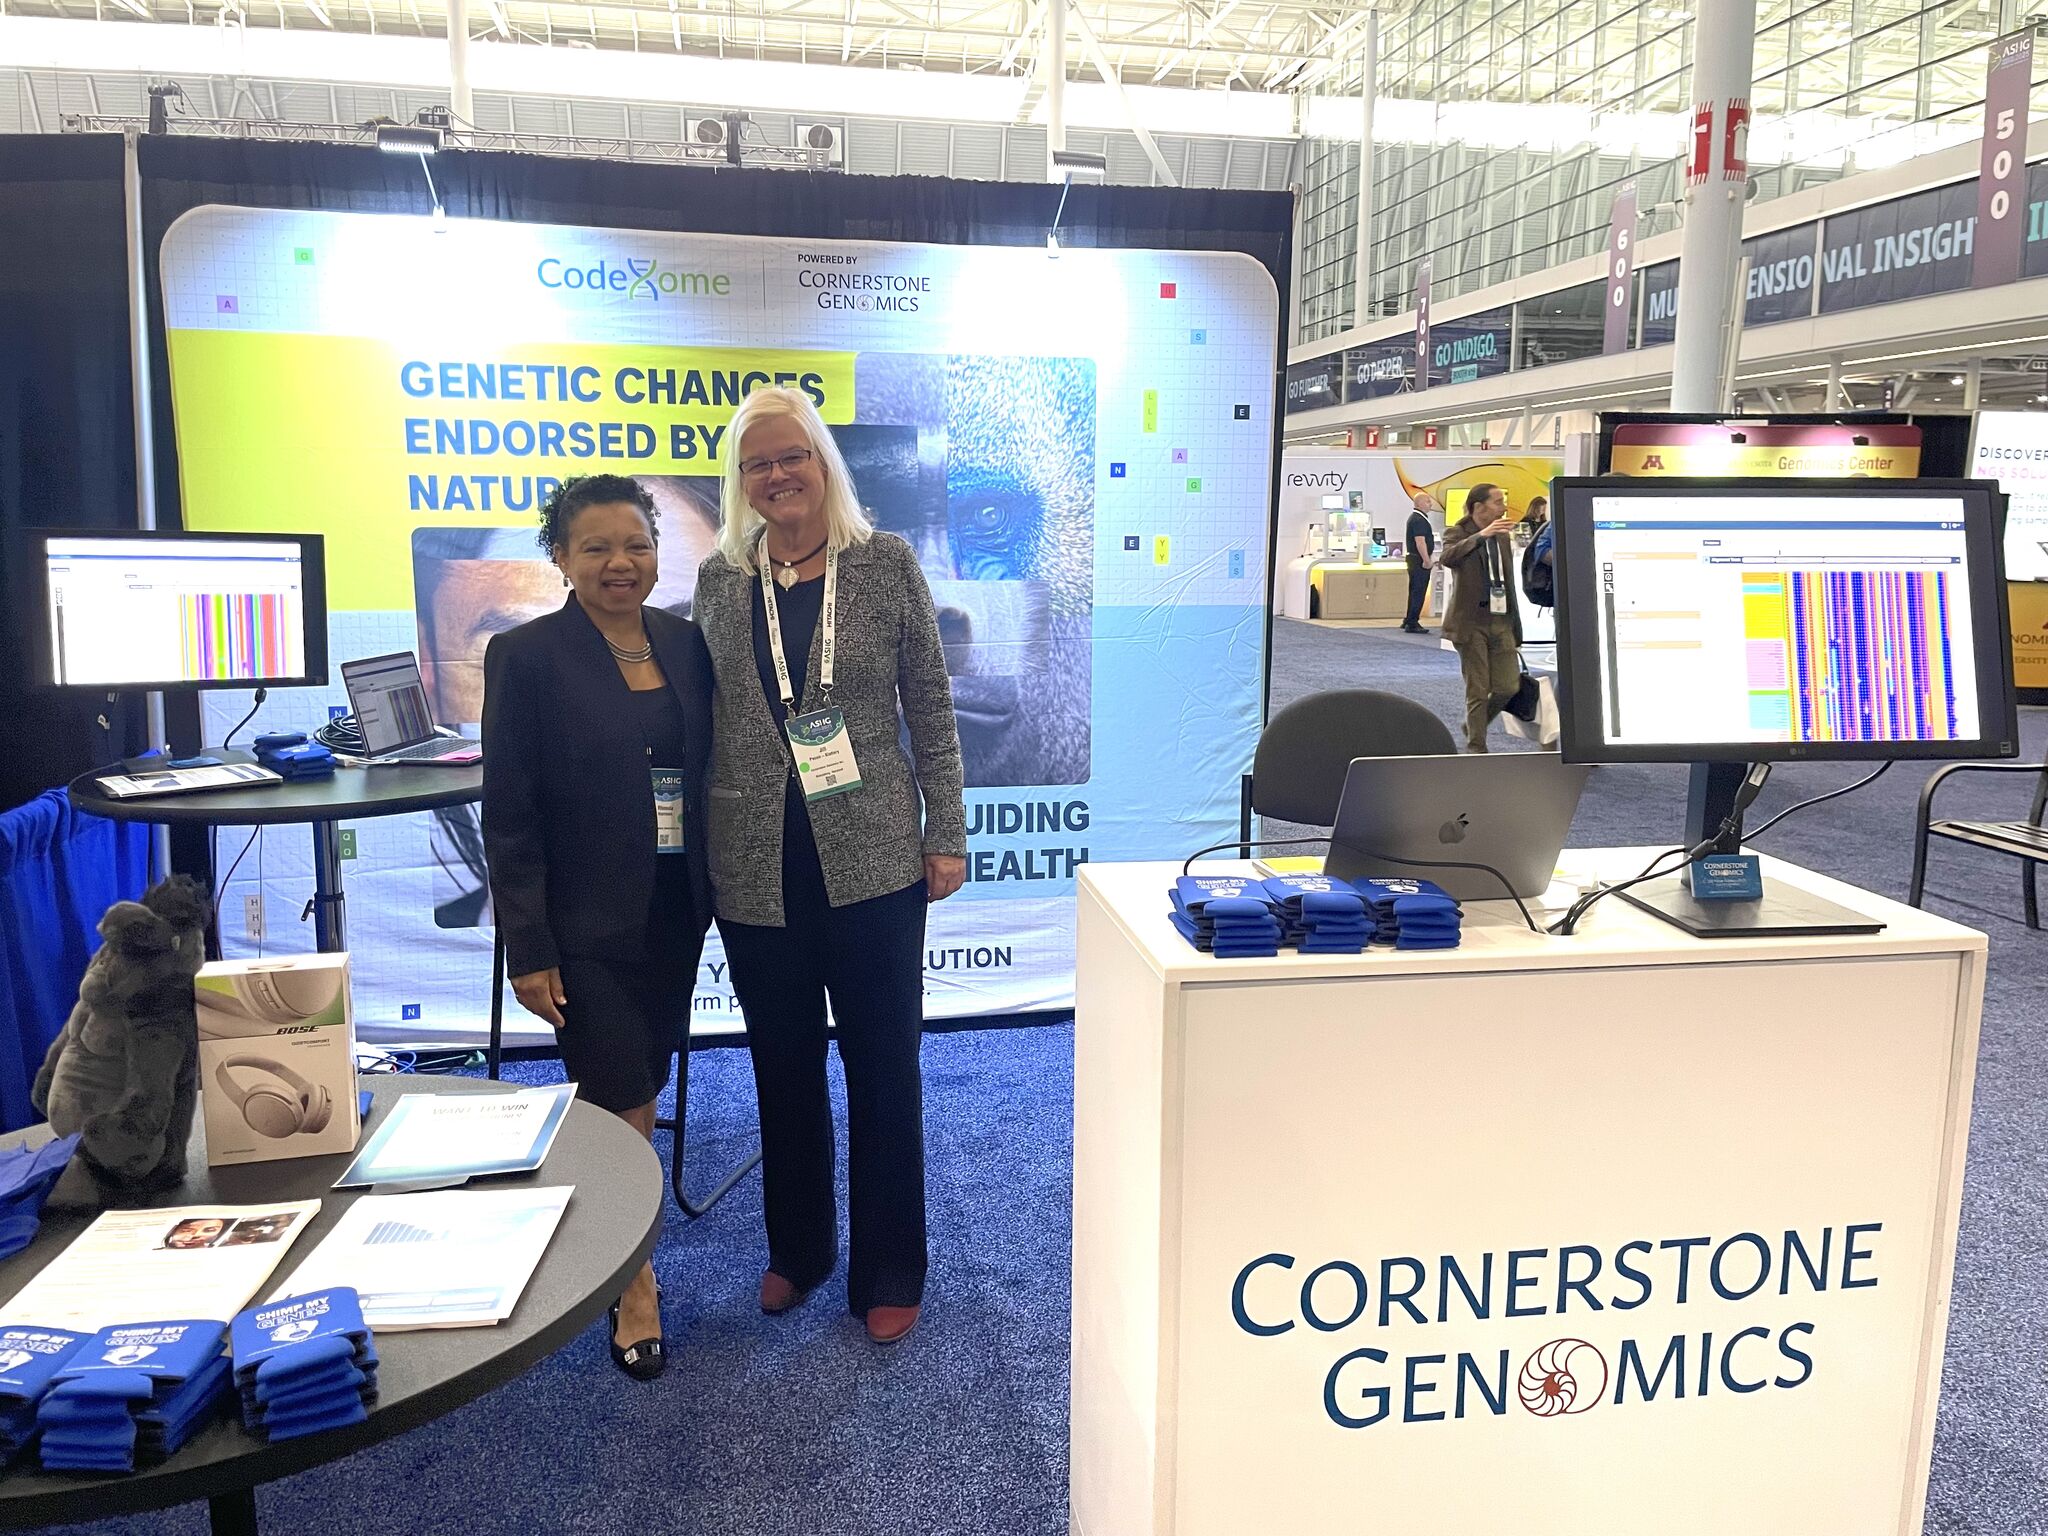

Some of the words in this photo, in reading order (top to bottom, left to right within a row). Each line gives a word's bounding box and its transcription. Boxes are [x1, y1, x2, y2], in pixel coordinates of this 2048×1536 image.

[1872, 216, 1978, 274] INSIGH
[797, 254, 842, 265] POWERED
[844, 256, 858, 265] BY
[798, 269, 931, 293] CORNERSTONE
[817, 292, 919, 313] GENOMICS
[1435, 345, 1450, 367] GO
[1452, 332, 1497, 363] INDIGO.
[400, 360, 601, 402] GENETIC
[1357, 365, 1370, 385] GO
[1288, 381, 1299, 399] GO
[404, 418, 657, 460] ENDORSED
[670, 424, 727, 461] BY
[1849, 456, 1894, 470] Center
[1287, 470, 1348, 492] revvity
[767, 596, 775, 621] HITACHI
[923, 946, 1012, 971] UTION
[276, 1025, 320, 1035] BOSE
[501, 1103, 529, 1111] WIN
[1231, 1222, 1883, 1338] CORNERSTONE
[255, 1303, 303, 1321] CHIMP
[305, 1296, 329, 1310] MY
[256, 1304, 330, 1330] GENES
[112, 1328, 161, 1337] CHIMP
[162, 1326, 190, 1335] MY
[1322, 1321, 1815, 1429] GENOMICS
